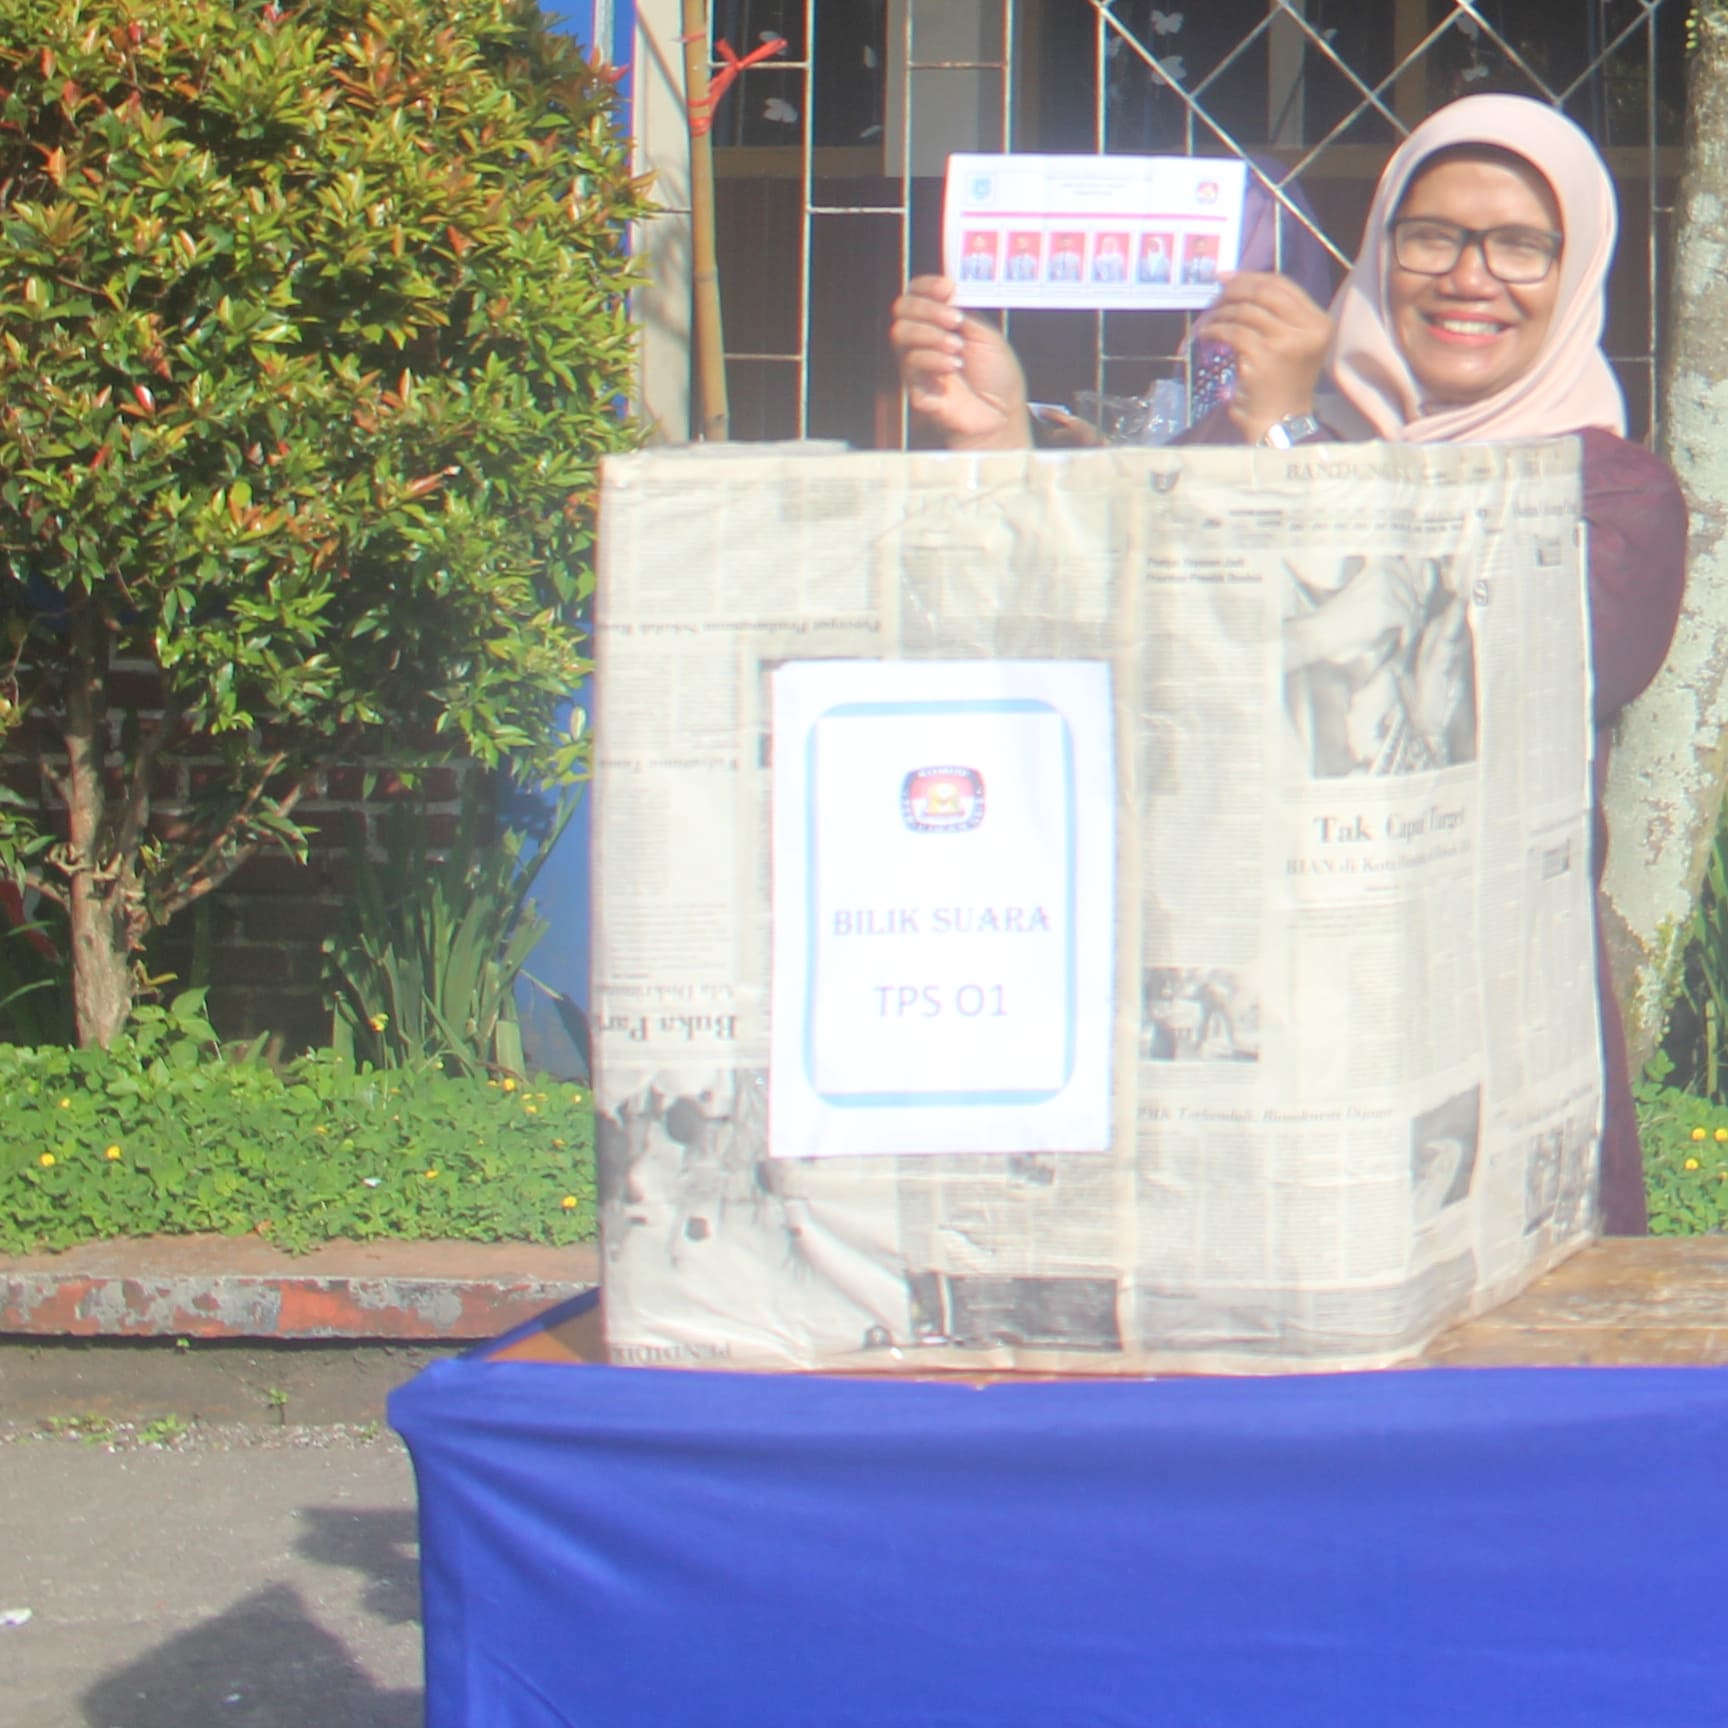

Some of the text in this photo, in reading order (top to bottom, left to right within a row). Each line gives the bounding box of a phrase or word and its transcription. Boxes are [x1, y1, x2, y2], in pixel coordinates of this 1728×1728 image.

[1313, 814, 1373, 844] Tak
[831, 904, 1052, 936] BILIK SUARA
[874, 984, 942, 1019] TPS
